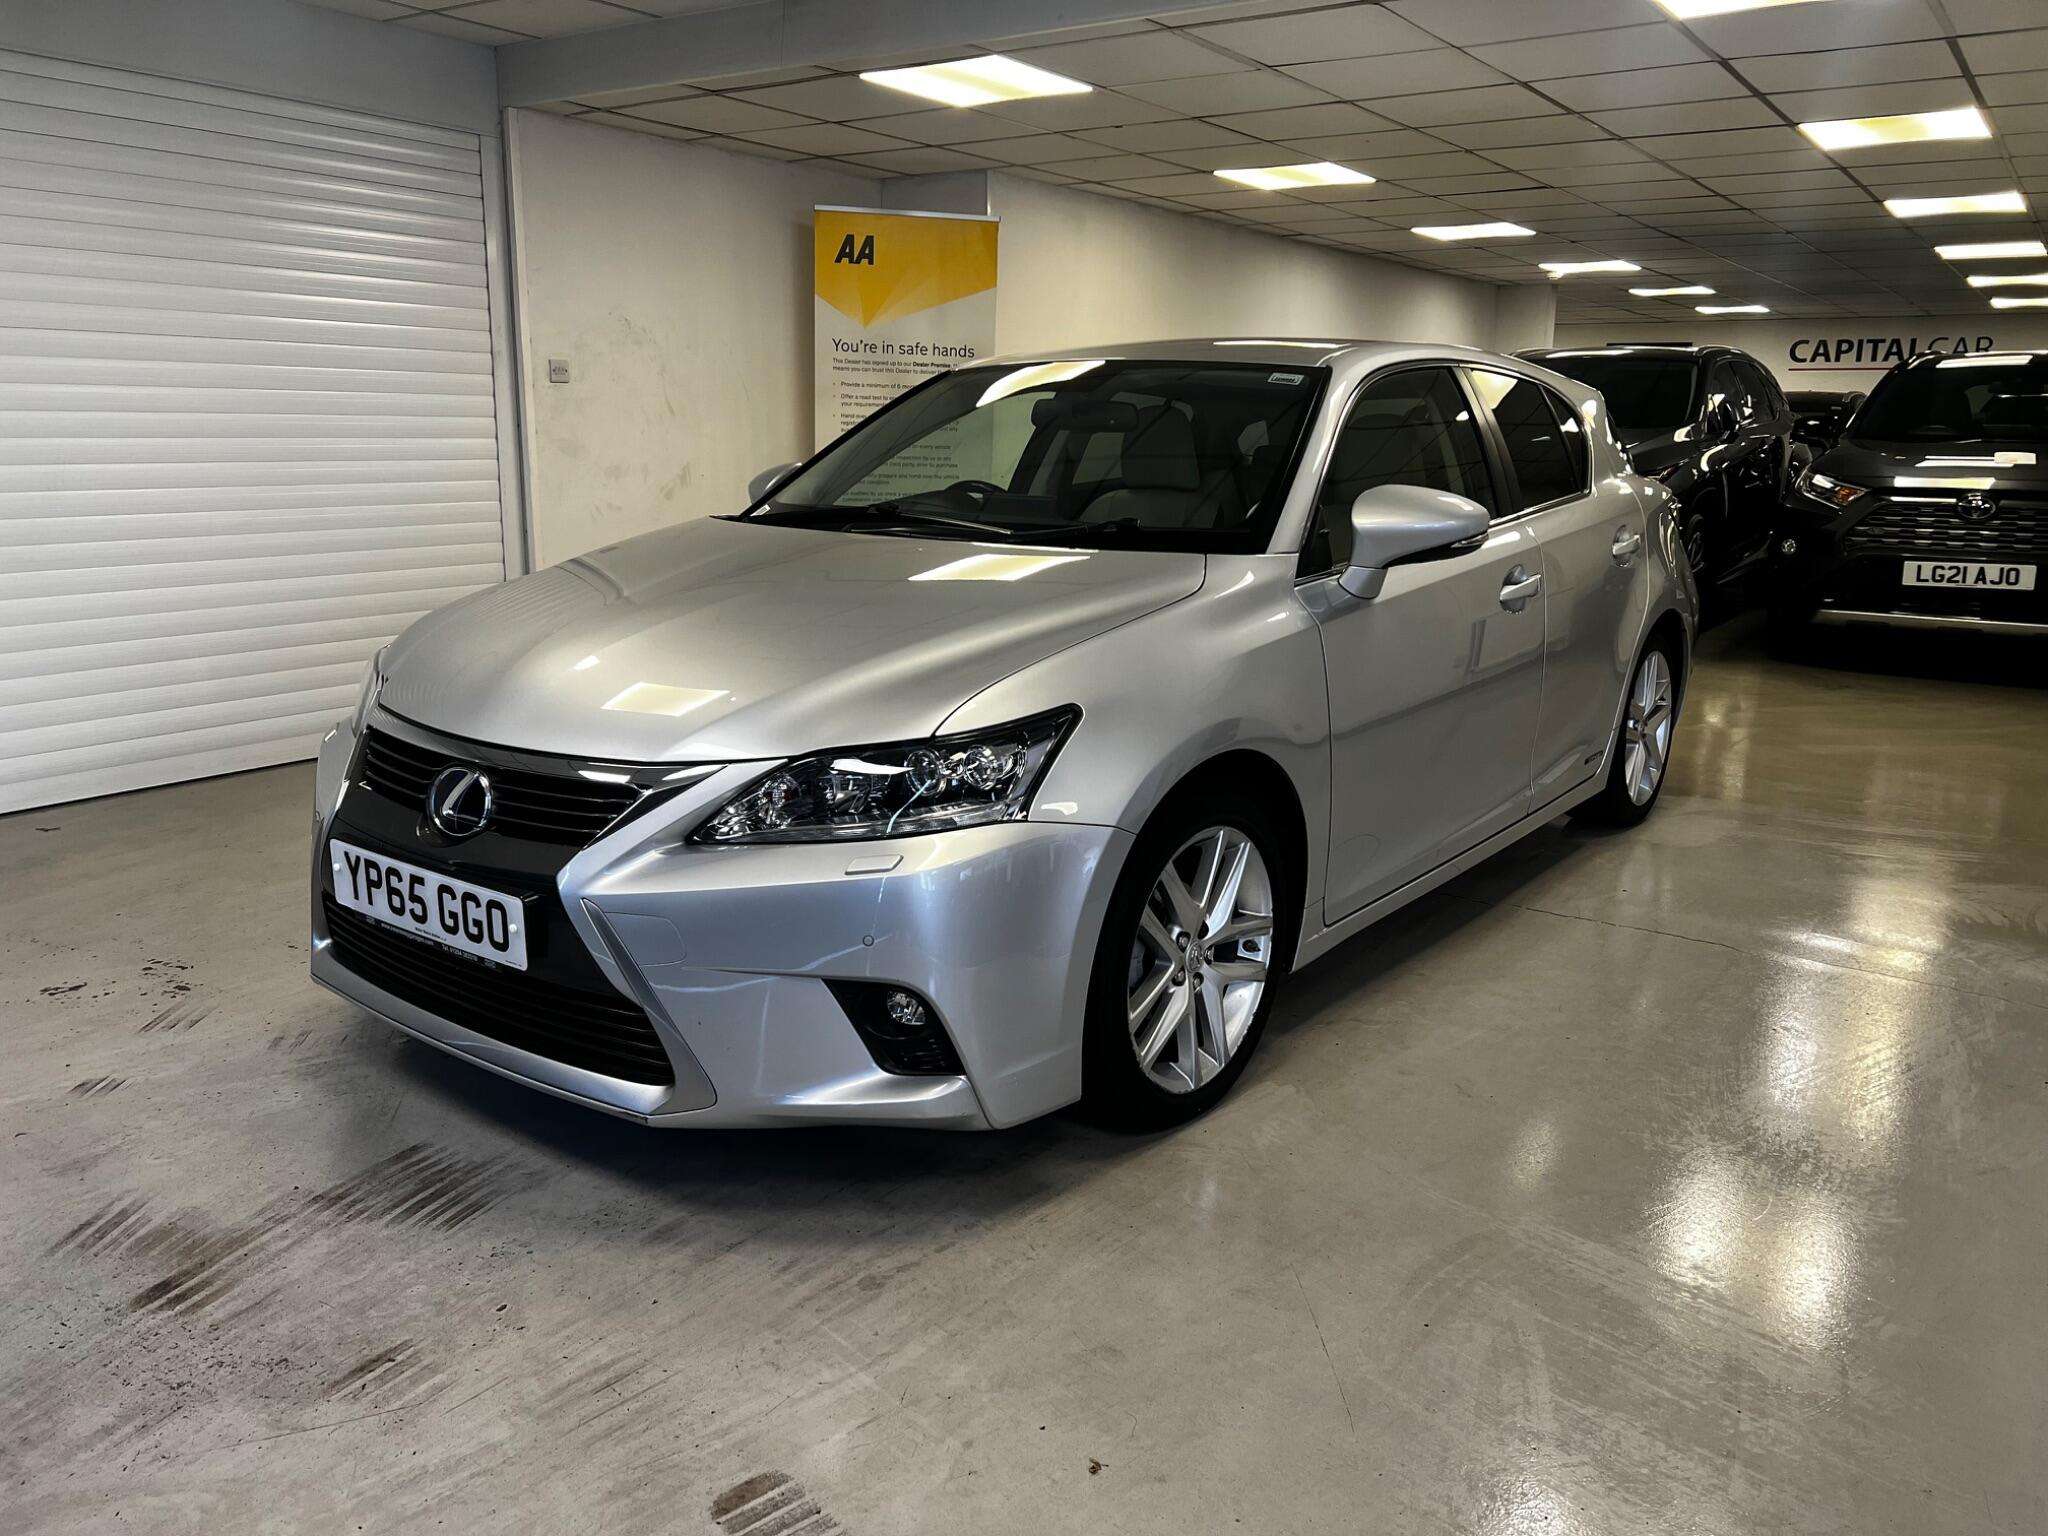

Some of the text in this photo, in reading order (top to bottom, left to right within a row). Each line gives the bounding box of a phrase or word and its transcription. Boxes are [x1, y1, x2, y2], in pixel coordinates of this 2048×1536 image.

[834, 234, 874, 265] AA
[832, 338, 975, 358] You're in safe hands
[1916, 564, 2020, 586] LG21 AJO
[344, 850, 510, 953] YP65 GGO
